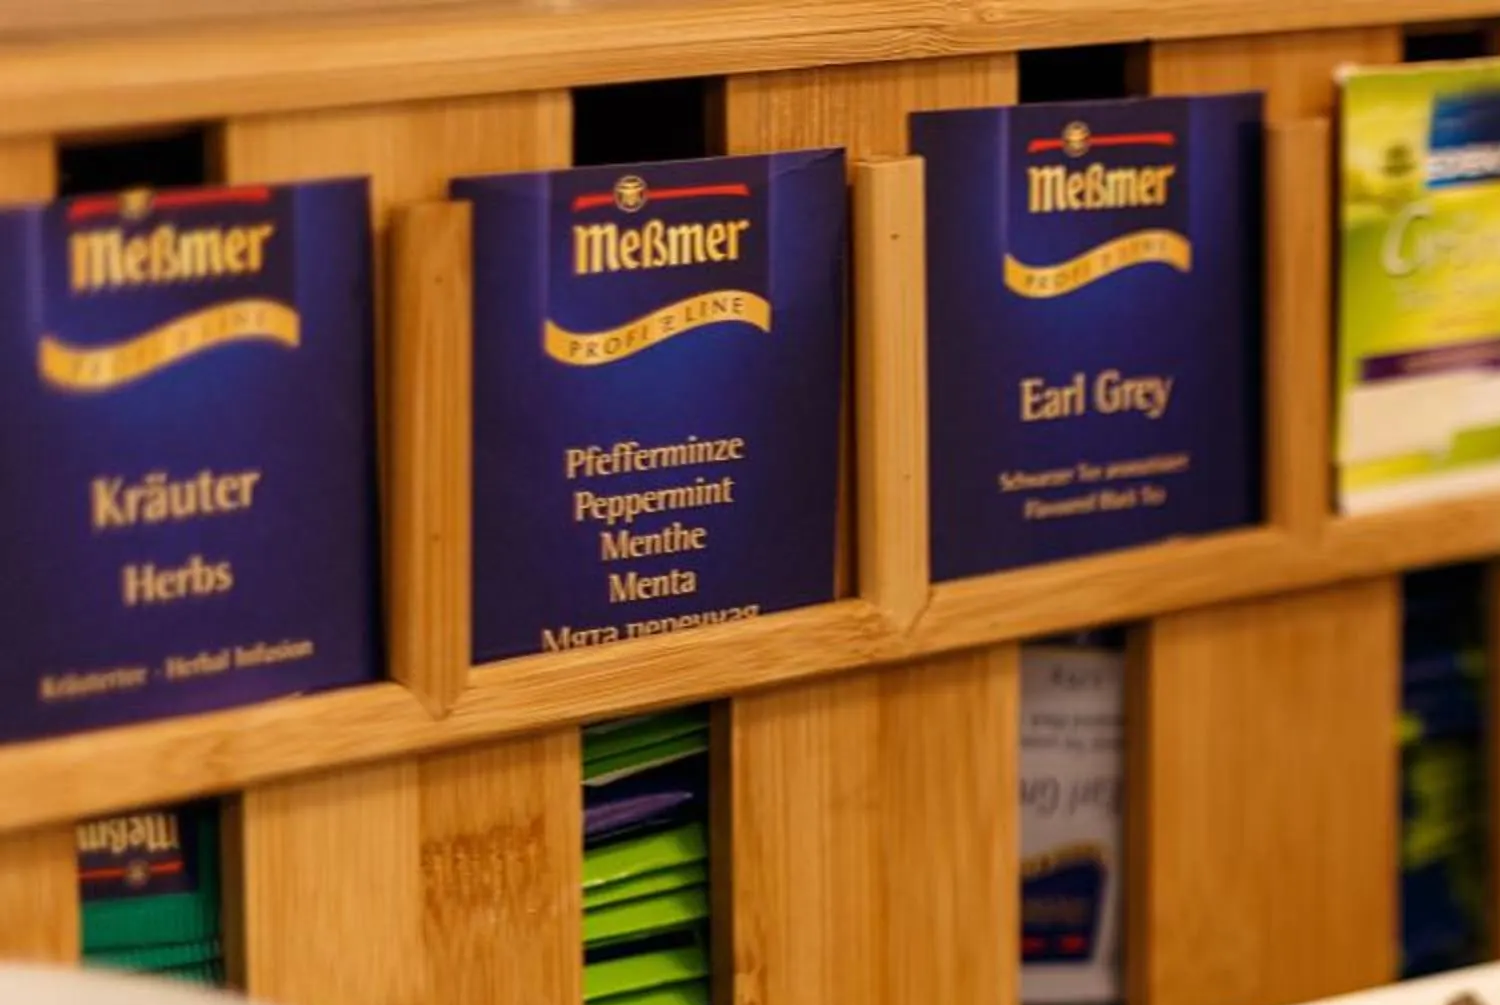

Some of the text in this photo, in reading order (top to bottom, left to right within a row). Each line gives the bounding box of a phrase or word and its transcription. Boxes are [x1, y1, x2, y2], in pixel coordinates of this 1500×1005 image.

[1027, 162, 1176, 213] Meßmer
[69, 222, 273, 292] Meßmer
[571, 219, 750, 276] Meßmer
[568, 297, 745, 359] PROFI LINE
[1020, 369, 1173, 422] Earl Grey
[565, 435, 745, 480] Pfefferminze
[91, 469, 260, 529] Kräuter
[573, 476, 735, 526] Peppermint
[601, 522, 707, 562] Menthe
[122, 555, 233, 606] Herbs
[609, 568, 697, 603] Menta
[76, 815, 179, 854] Meßm
